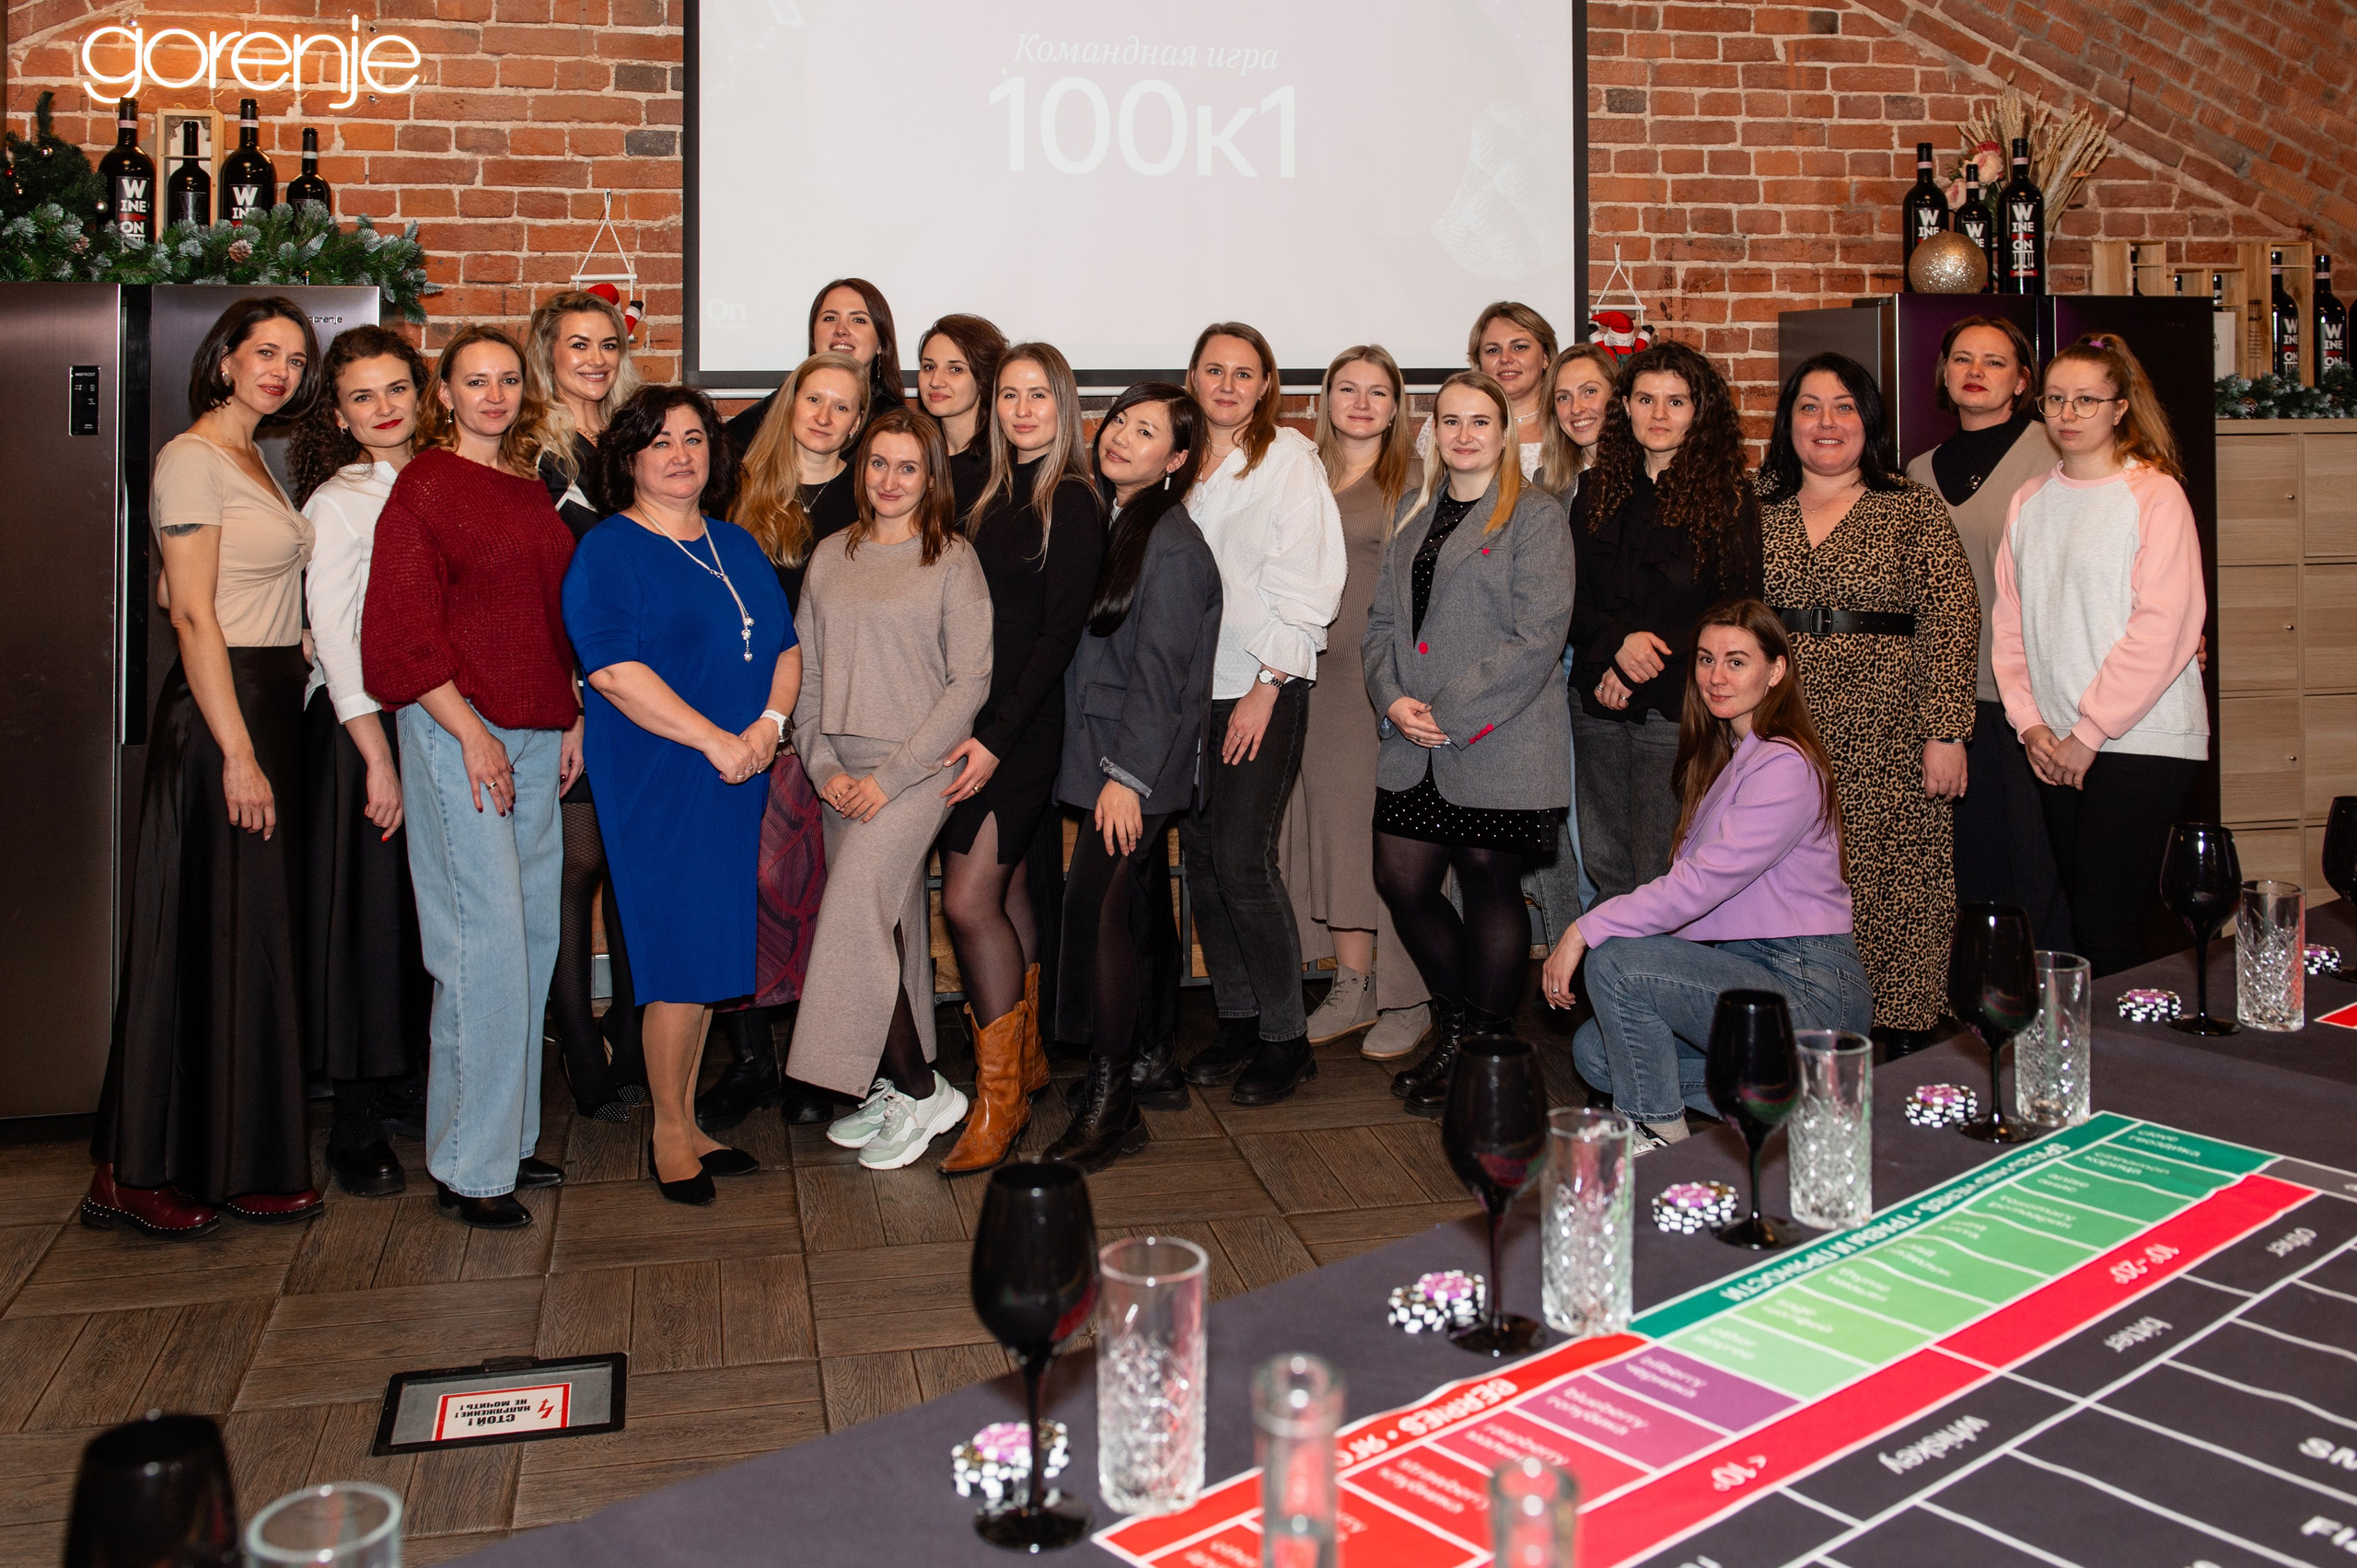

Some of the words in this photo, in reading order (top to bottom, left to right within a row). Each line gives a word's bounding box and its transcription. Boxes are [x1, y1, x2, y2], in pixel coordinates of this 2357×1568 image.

[82, 14, 421, 109] gorenje
[1013, 34, 1198, 67] Командная
[1207, 48, 1279, 75] игра
[122, 179, 147, 199] W
[233, 187, 259, 206] W
[121, 200, 146, 213] INE
[232, 207, 255, 218] IN
[2013, 204, 2034, 221] W
[1919, 209, 1939, 226] W
[121, 221, 145, 234] ON
[1966, 223, 1984, 238] W
[2012, 222, 2035, 232] INE
[2013, 239, 2033, 250] ON
[707, 298, 747, 321] On
[308, 315, 343, 324] gorenje
[2324, 323, 2342, 339] W
[2324, 340, 2343, 349] INE
[2324, 356, 2343, 366] ON
[461, 1405, 531, 1417] НАПРЯЖЕНИЕ
[466, 1400, 510, 1410] МОЧИТЬ
[1398, 1377, 1518, 1436] BERRIES
[477, 1414, 516, 1427] СТОЙ
[1877, 1414, 1991, 1475] whiskey
